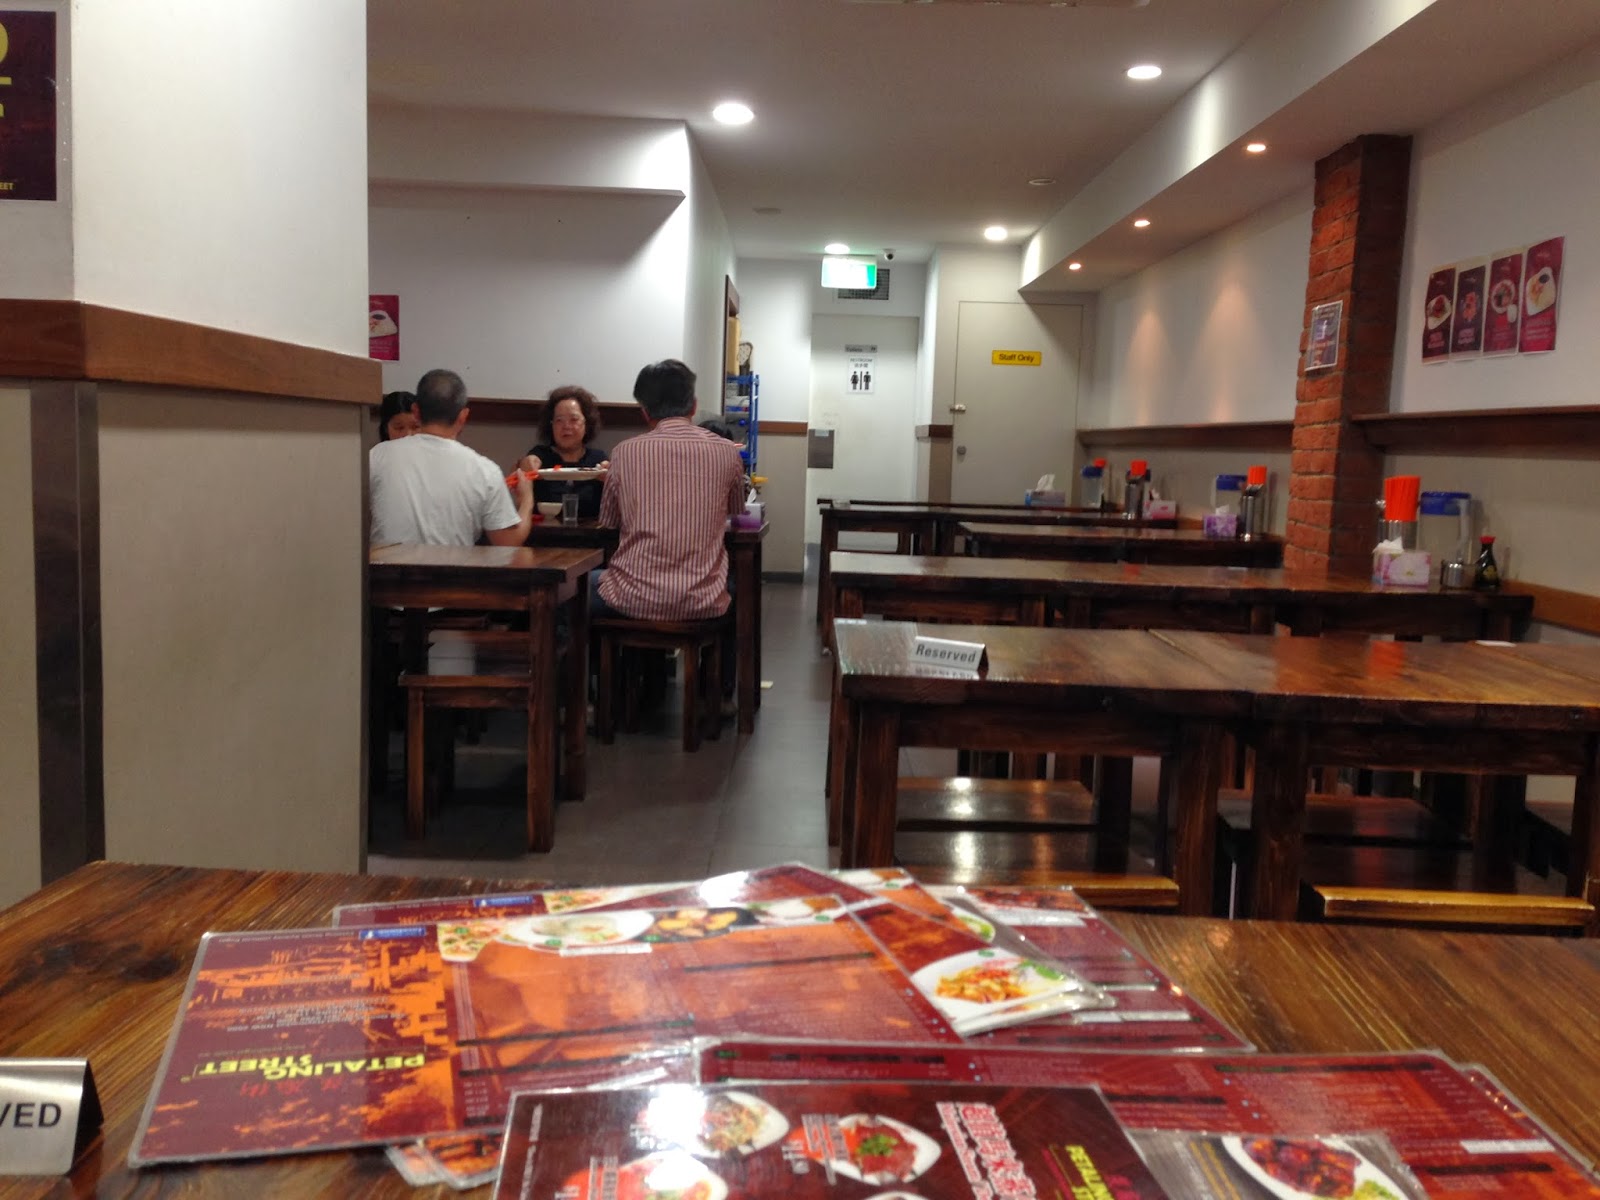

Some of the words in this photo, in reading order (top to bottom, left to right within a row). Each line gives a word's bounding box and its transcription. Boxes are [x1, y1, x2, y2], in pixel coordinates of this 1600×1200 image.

[1018, 355, 1035, 363] Only
[916, 643, 977, 663] Reserved
[198, 1053, 313, 1075] STREET
[264, 1053, 426, 1081] PETALING
